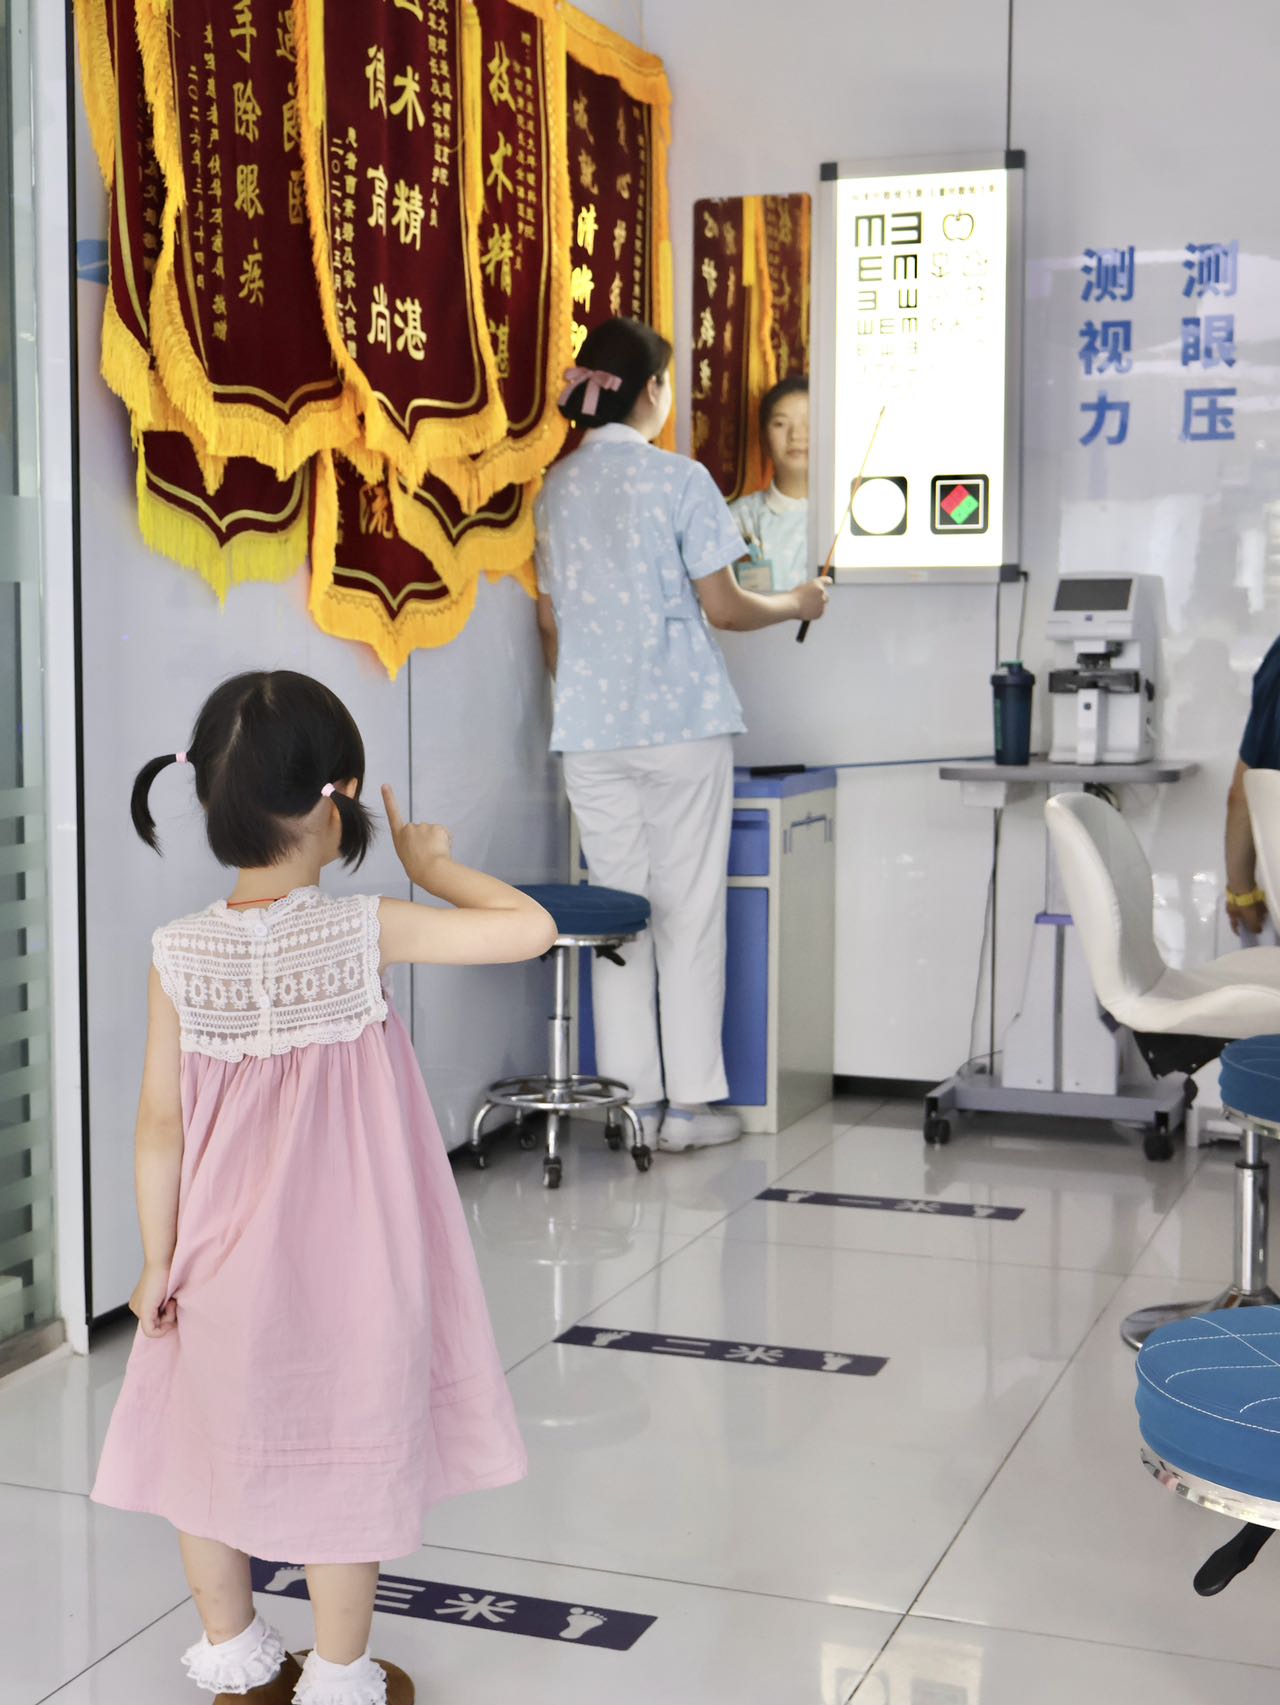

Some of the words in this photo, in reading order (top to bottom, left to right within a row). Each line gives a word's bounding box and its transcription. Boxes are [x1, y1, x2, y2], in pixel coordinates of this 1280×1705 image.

[1078, 245, 1135, 446] 测视力
[1180, 240, 1239, 441] 测眼压
[837, 1198, 941, 1214] 一米
[651, 1338, 784, 1364] 二米
[373, 1580, 518, 1623] 三米
